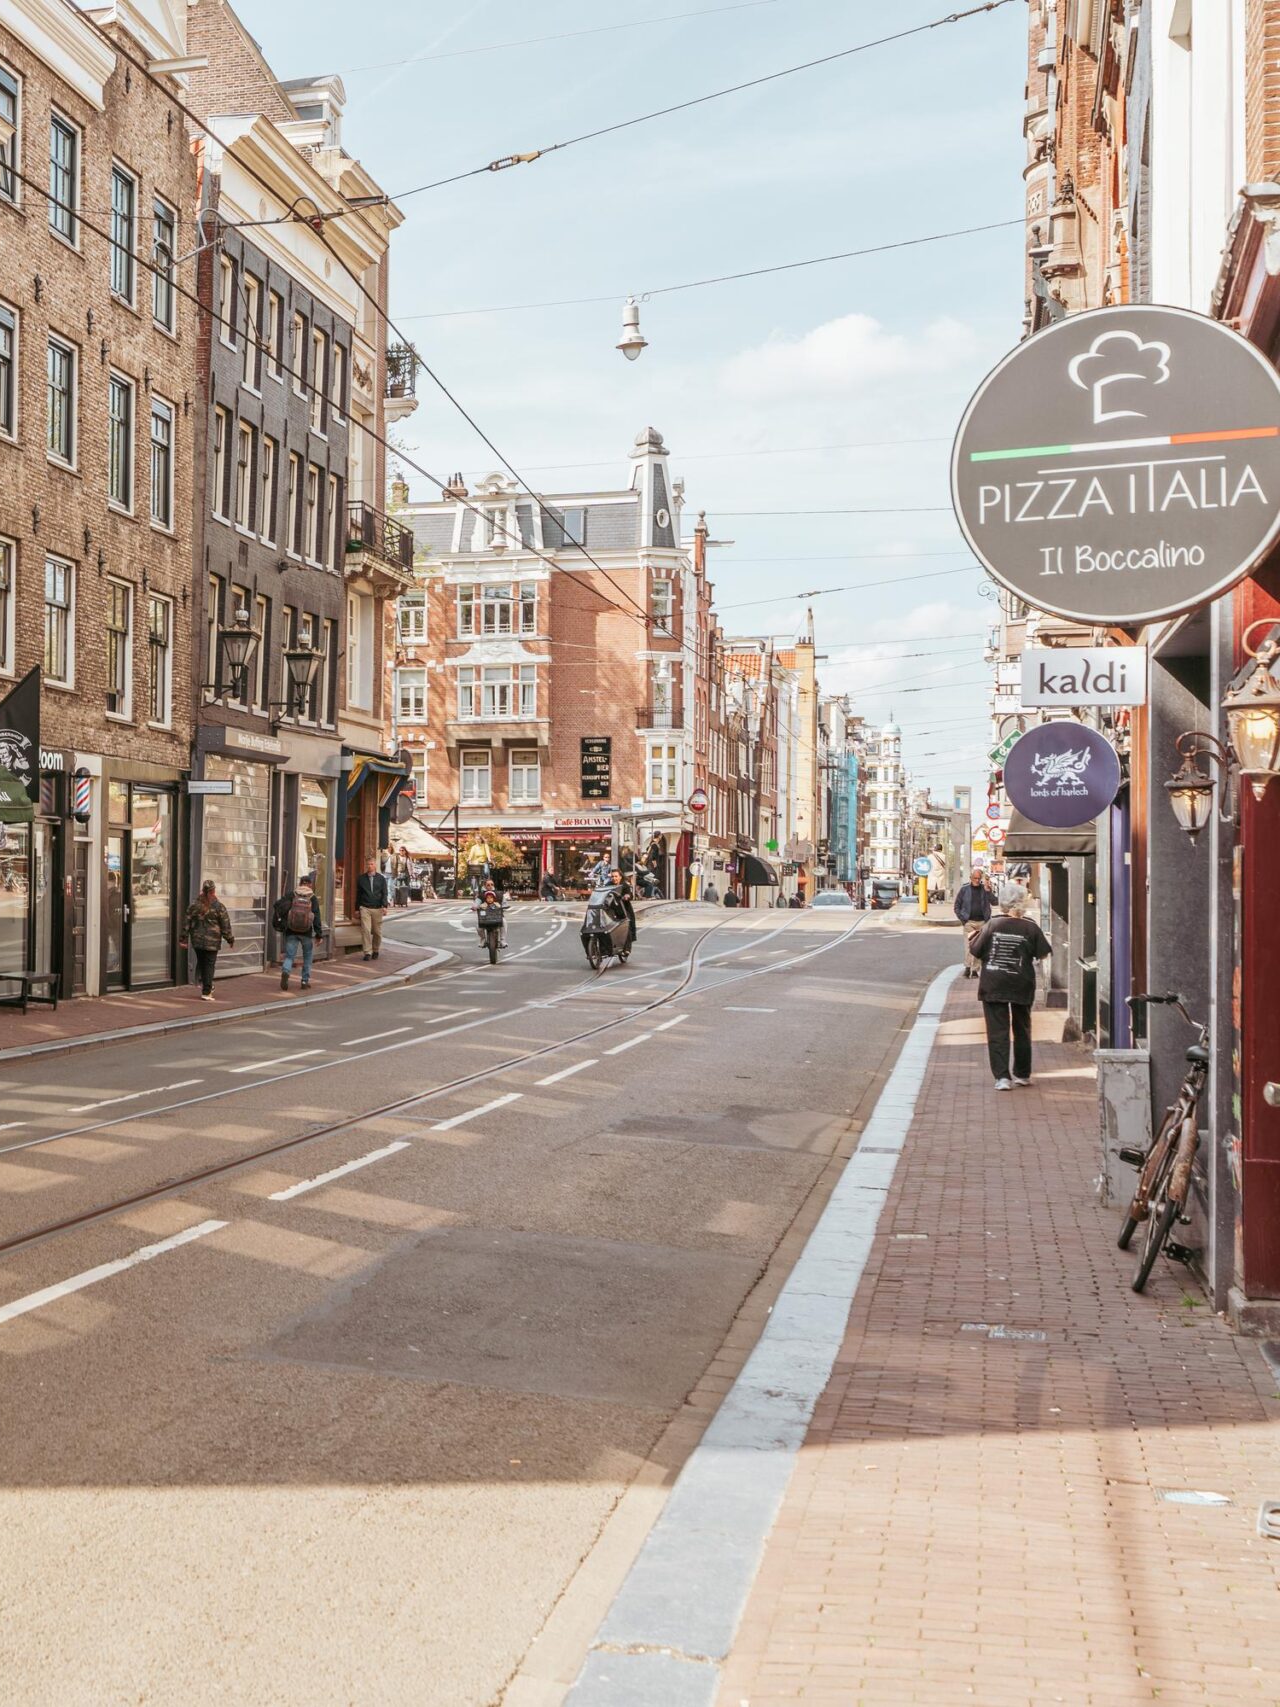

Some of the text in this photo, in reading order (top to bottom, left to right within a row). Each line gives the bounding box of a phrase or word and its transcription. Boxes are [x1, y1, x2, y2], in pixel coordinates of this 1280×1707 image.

[979, 463, 1269, 524] PIZZA ITALIA
[1039, 540, 1205, 576] Il Boccalino
[1039, 658, 1127, 694] kaldi
[1030, 787, 1050, 797] lords
[1061, 786, 1089, 797] harlech
[555, 818, 611, 826] Café BOUWM
